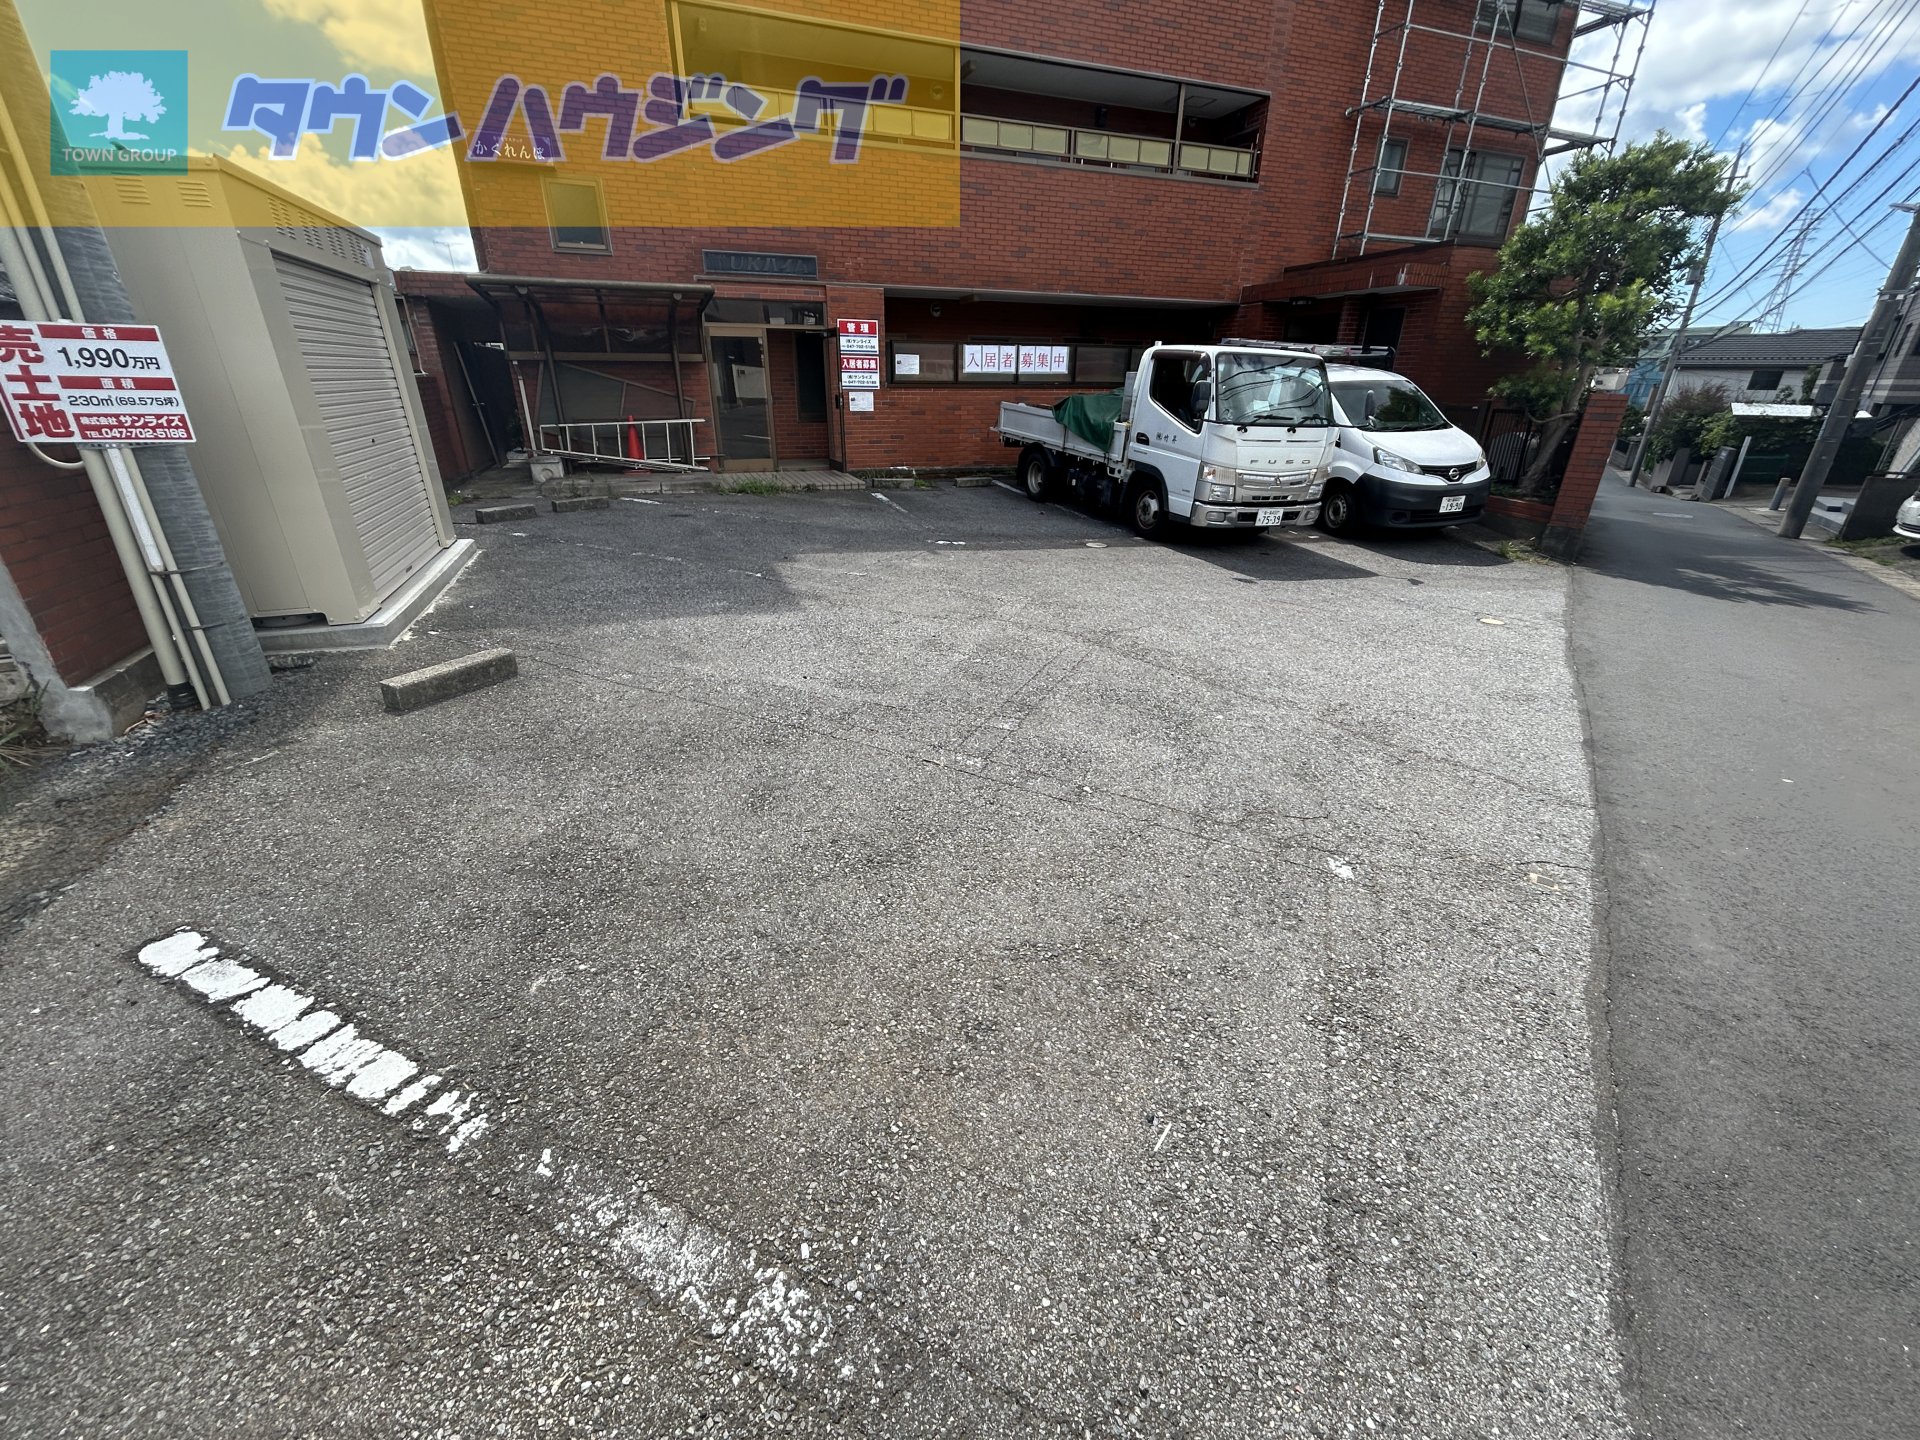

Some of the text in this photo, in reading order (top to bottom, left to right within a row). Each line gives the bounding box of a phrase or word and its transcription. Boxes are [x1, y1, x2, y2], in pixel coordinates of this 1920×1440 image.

[475, 140, 545, 160] かくれんぼ
[81, 327, 117, 340] 価格
[847, 322, 869, 333] 管理
[57, 347, 161, 370] 1,990万円
[842, 359, 877, 369] 入居者募集
[966, 352, 1065, 368] 入居者募集中
[100, 378, 136, 390] 面積
[1260, 515, 1281, 525] 75-39
